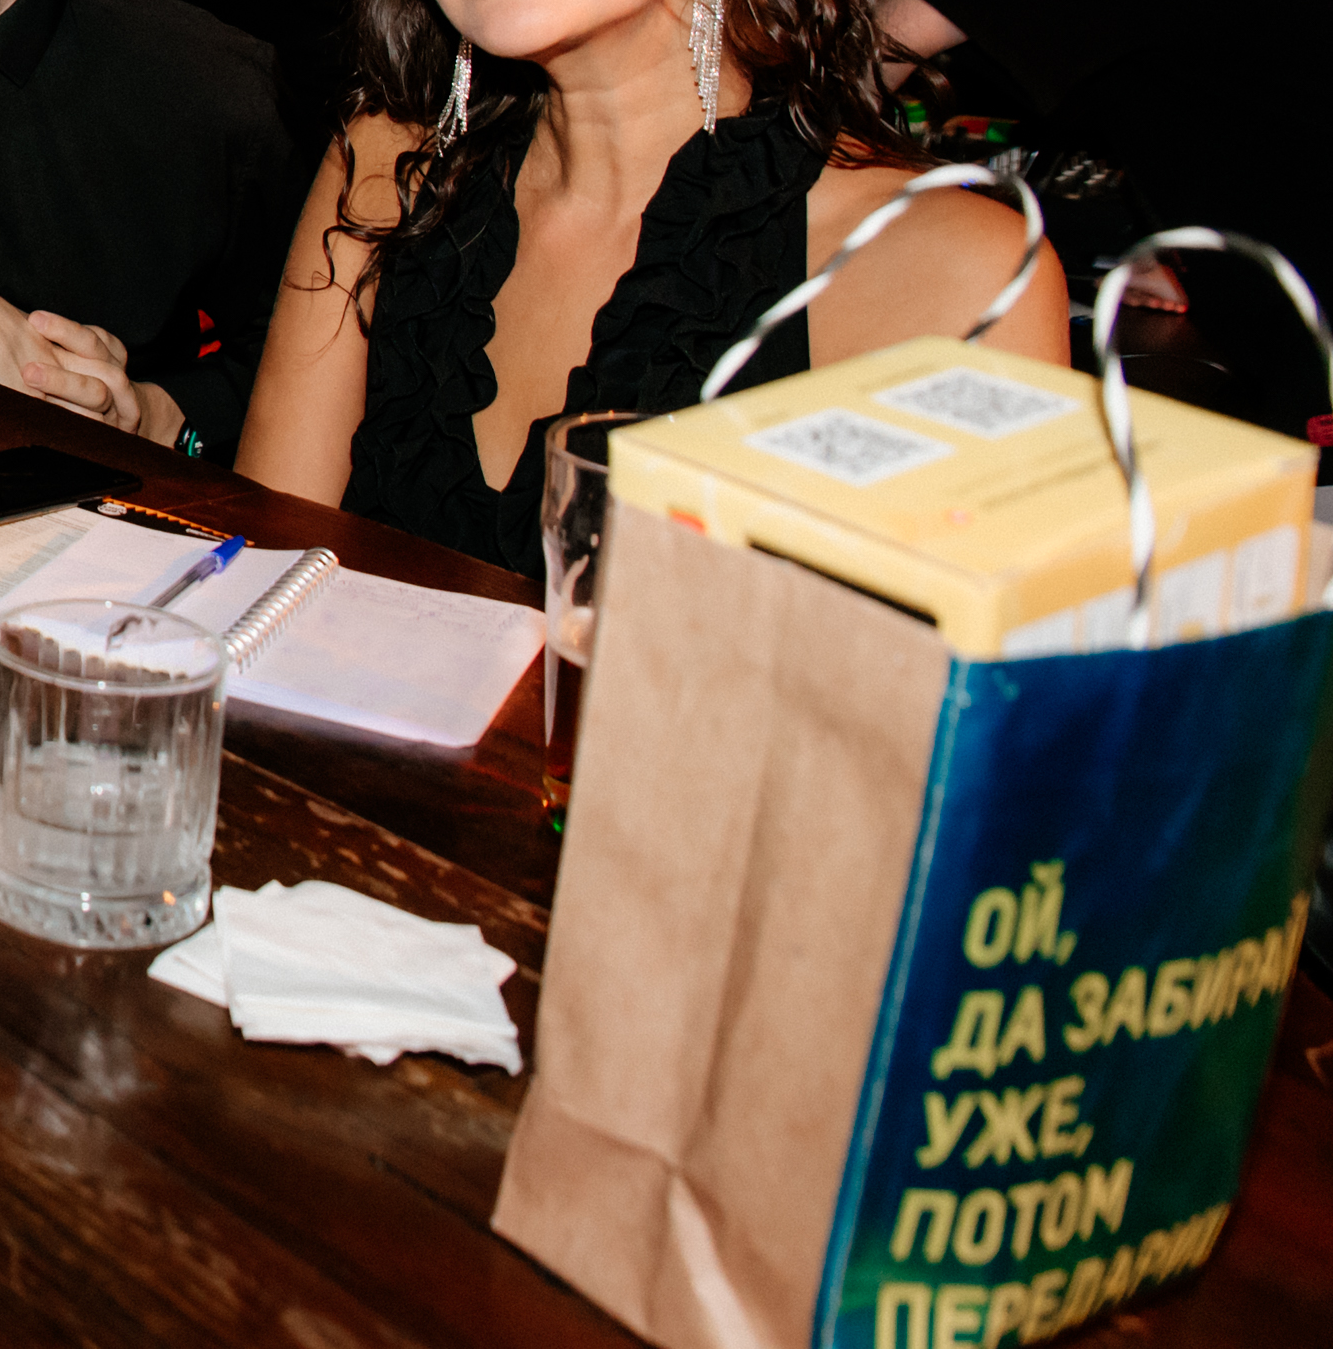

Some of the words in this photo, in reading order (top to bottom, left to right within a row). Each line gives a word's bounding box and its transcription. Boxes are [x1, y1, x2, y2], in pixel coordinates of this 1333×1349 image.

[963, 857, 1078, 968] ОЙ,
[931, 985, 1046, 1080] ДА
[915, 1075, 1093, 1169] УЖЕ,
[890, 1157, 1133, 1266] ПОТОМ
